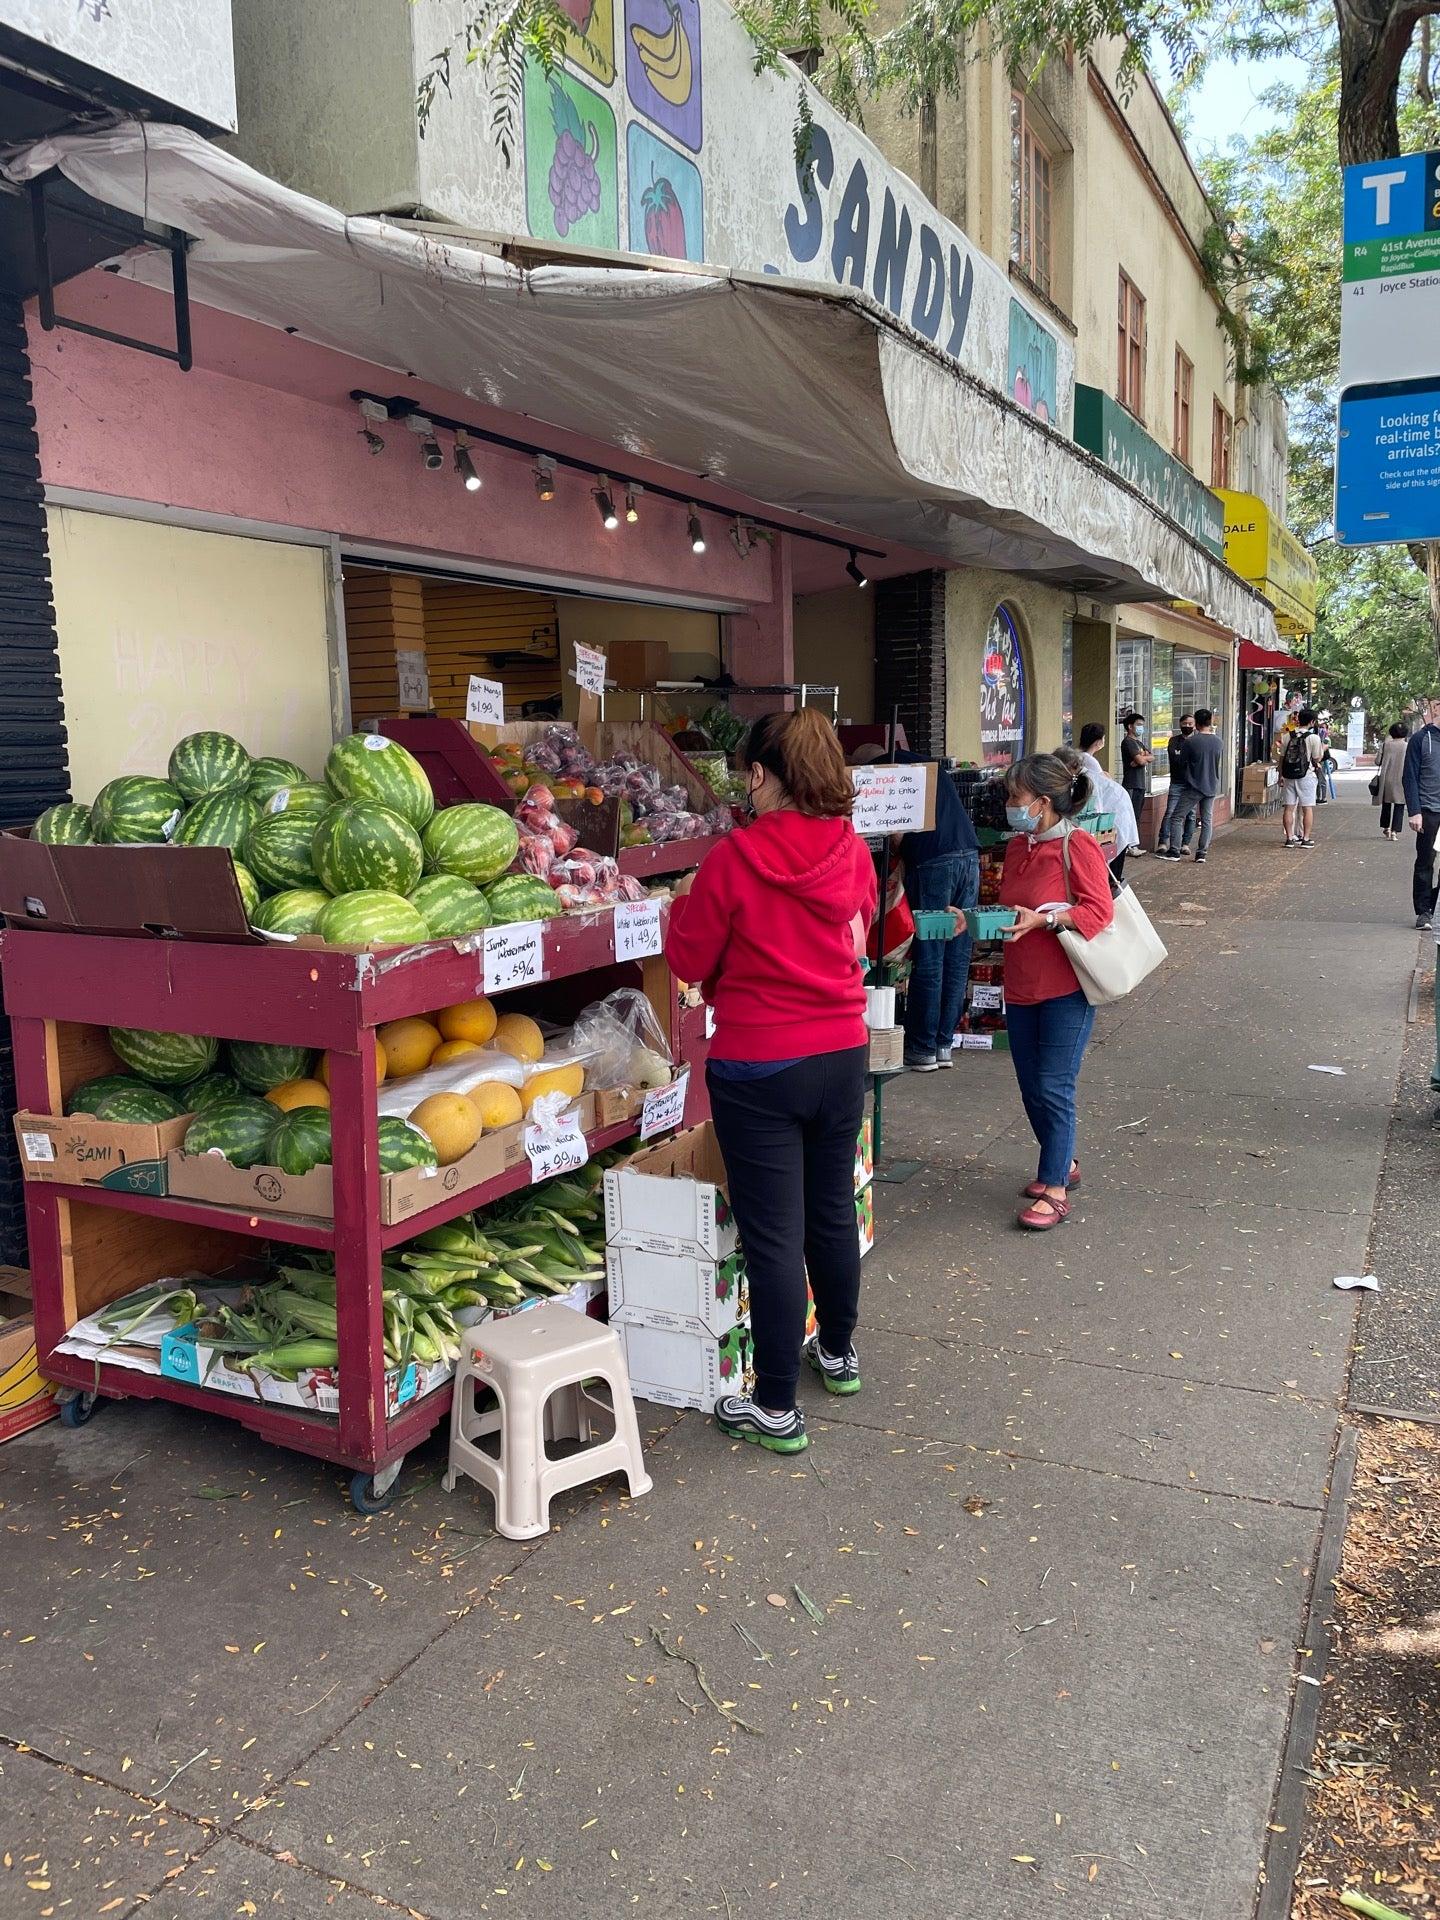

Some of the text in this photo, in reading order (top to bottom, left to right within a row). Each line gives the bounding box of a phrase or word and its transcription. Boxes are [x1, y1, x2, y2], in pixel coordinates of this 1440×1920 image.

[1362, 171, 1407, 225] T
[784, 122, 974, 358] SANDY
[1381, 241, 1403, 252] 41st
[1354, 247, 1368, 257] R4
[1353, 286, 1365, 296] 41
[1379, 276, 1440, 294] Joyce Statio
[1380, 412, 1430, 428] Looking
[1375, 428, 1430, 445] real-time
[1387, 443, 1440, 460] arrivals?
[1380, 470, 1401, 479] Check
[1403, 469, 1415, 477] out
[1416, 467, 1429, 476] the
[1385, 481, 1401, 490] side
[1402, 480, 1410, 488] of
[1411, 478, 1426, 487] this
[856, 775, 872, 786] Face
[76, 1146, 112, 1162] SAMI
